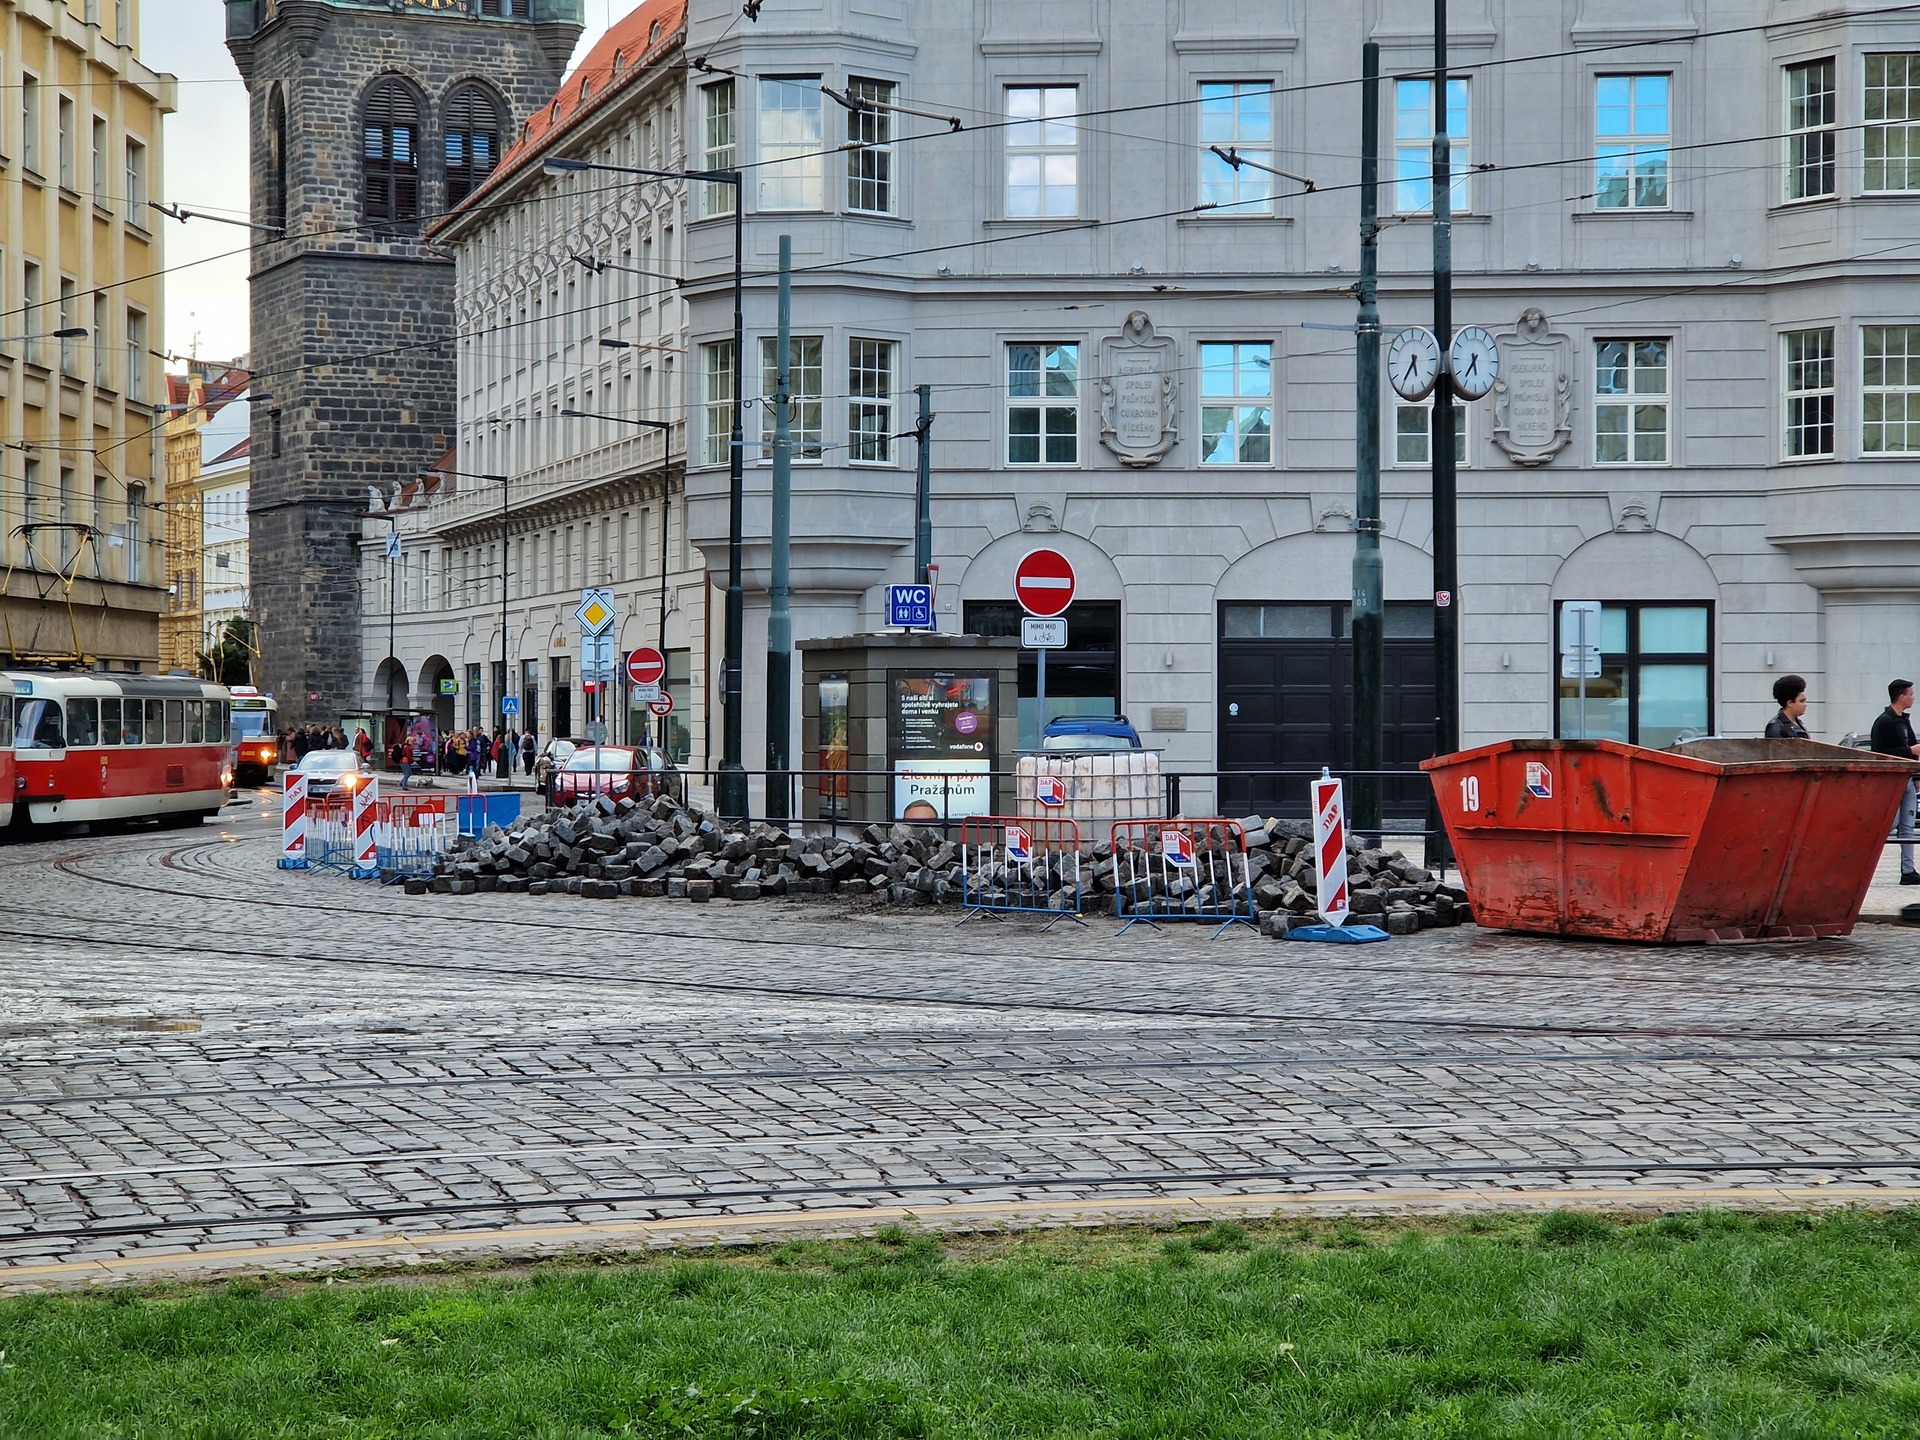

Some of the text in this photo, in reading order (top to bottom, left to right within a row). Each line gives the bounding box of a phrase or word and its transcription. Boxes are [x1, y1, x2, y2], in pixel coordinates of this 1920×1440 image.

[1125, 381, 1153, 390] SPOLEK
[1520, 379, 1545, 388] SPOLEK
[1121, 392, 1156, 403] PRŮMYSLU
[896, 589, 926, 604] WC
[901, 701, 959, 709] spolehlivě vyhrajete
[288, 786, 303, 800] DAP
[910, 784, 975, 795] Pražanům
[1460, 775, 1480, 812] 19
[1322, 804, 1338, 831] DAP
